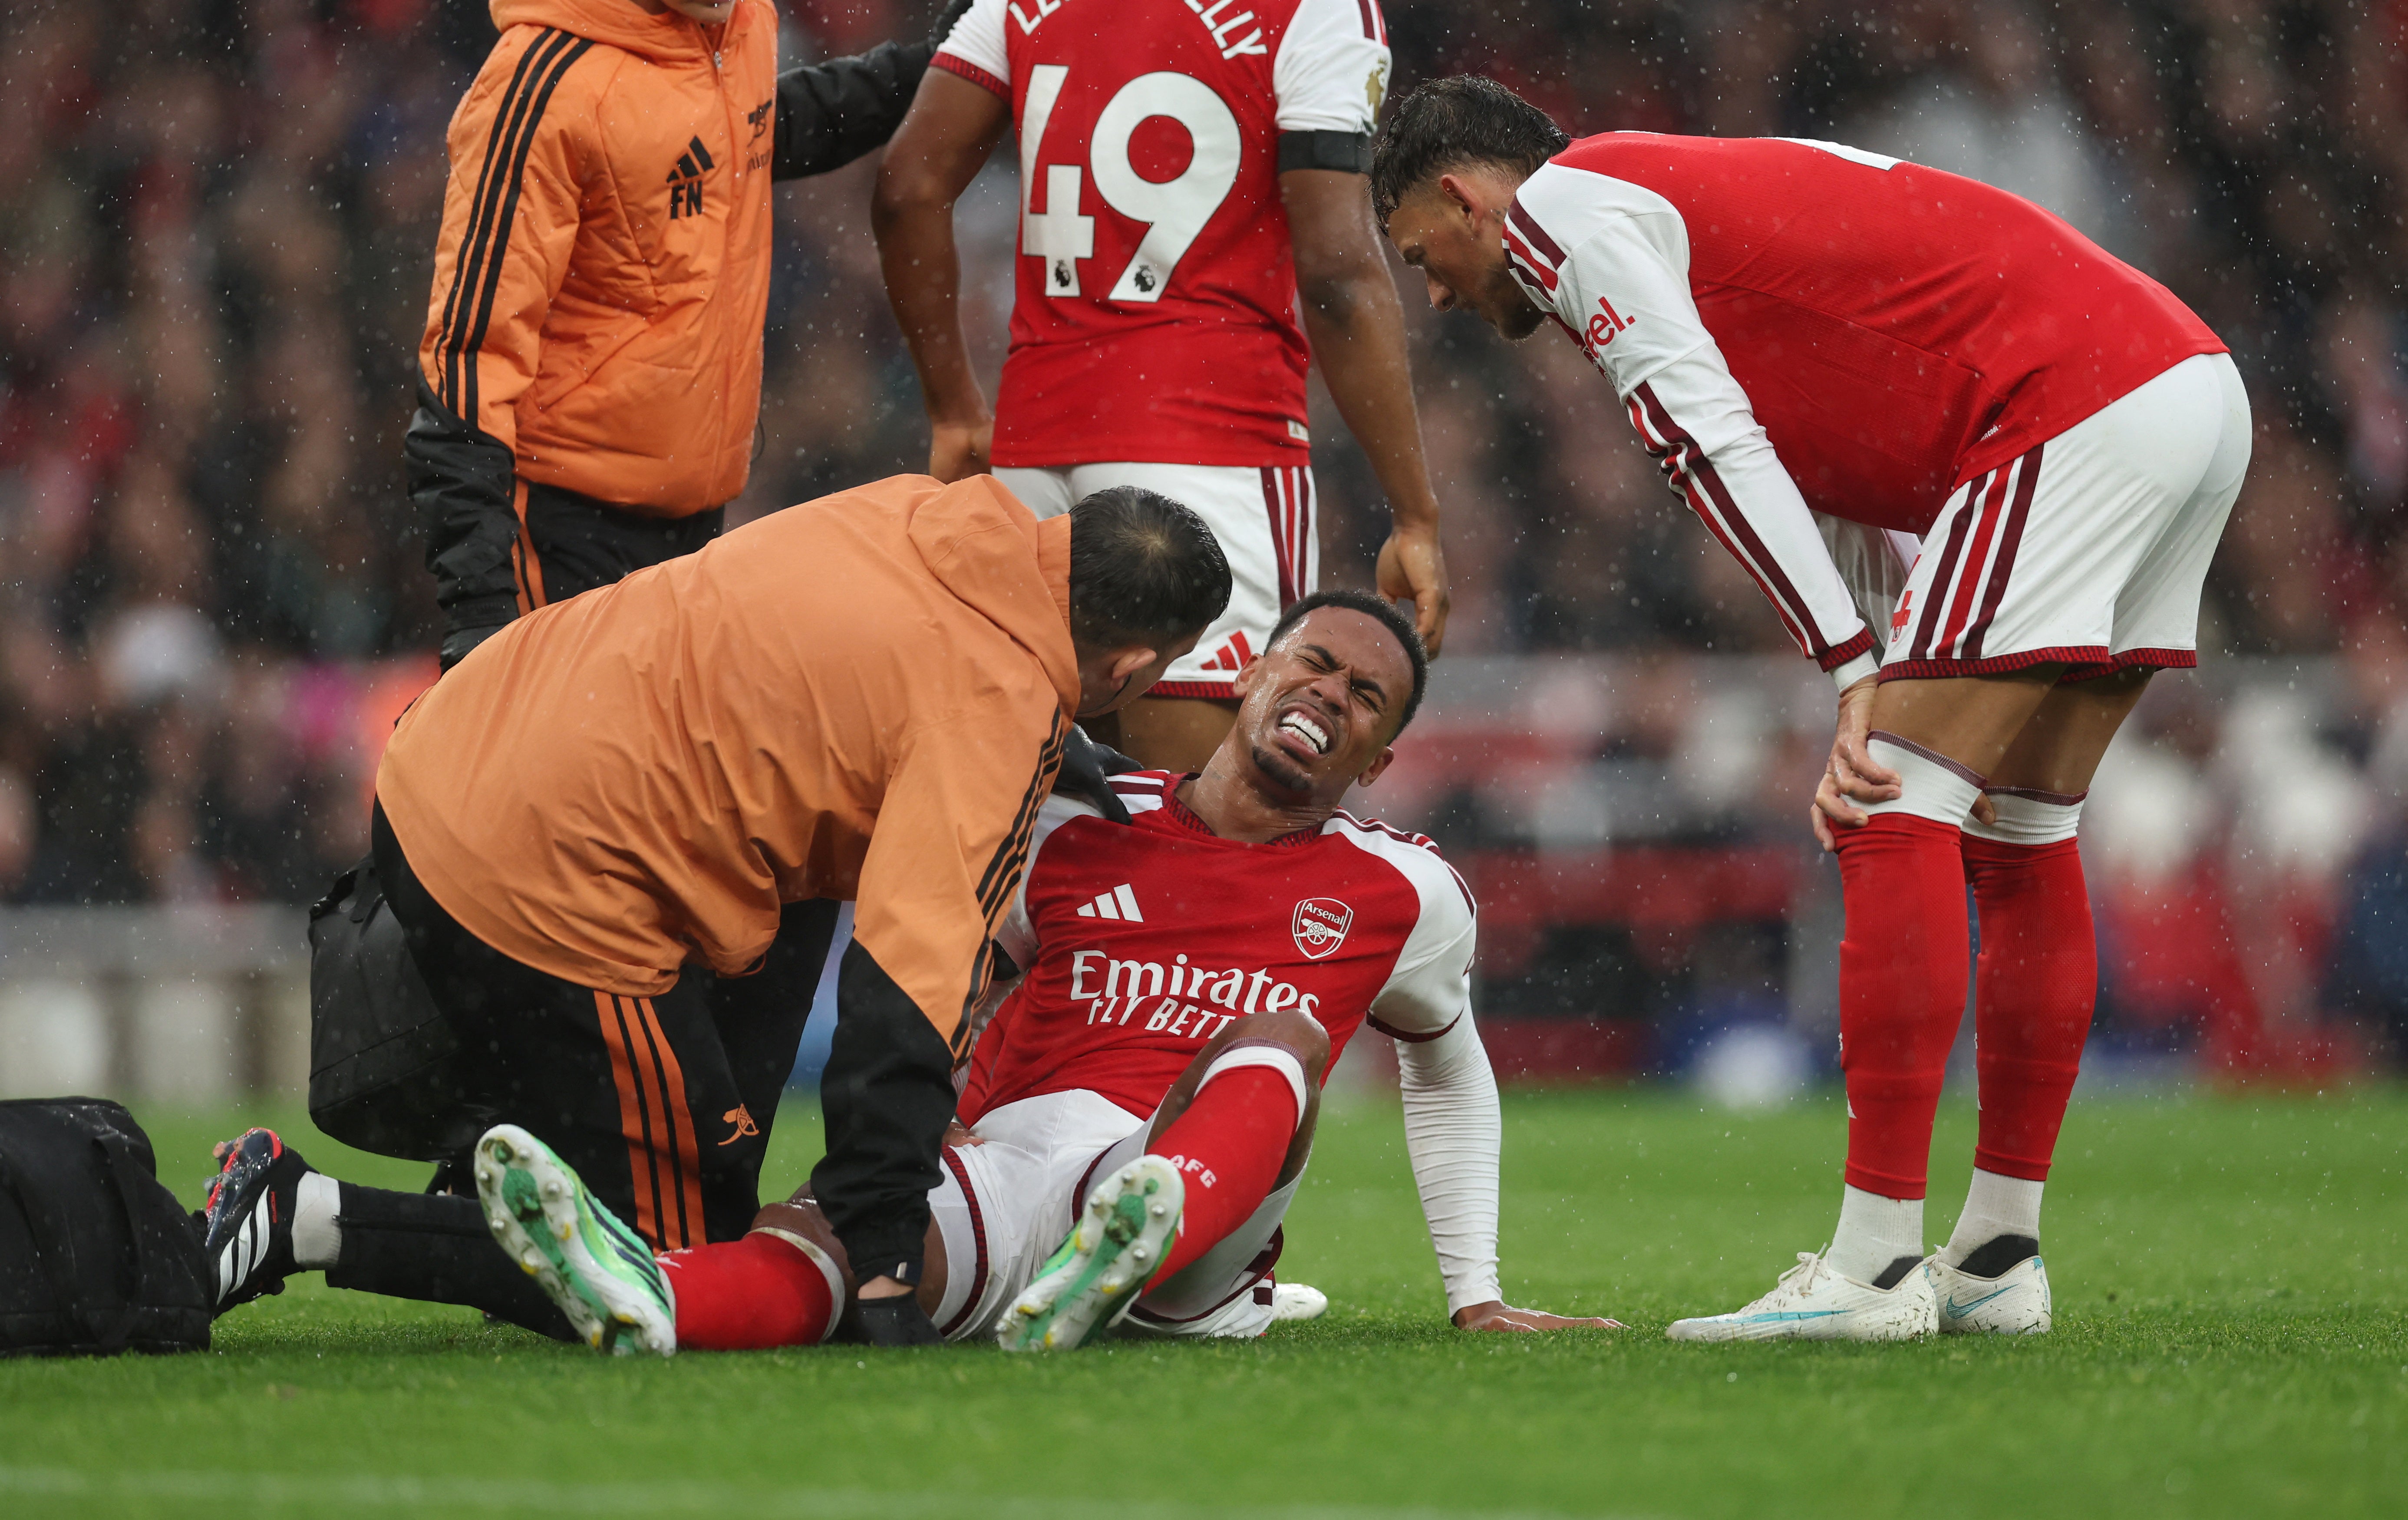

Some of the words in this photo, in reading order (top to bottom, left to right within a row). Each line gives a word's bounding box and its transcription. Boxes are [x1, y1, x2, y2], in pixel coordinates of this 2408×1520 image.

[670, 180, 703, 219] FN
[1020, 64, 1242, 303] 49
[1304, 902, 1345, 925] Arsenal
[1070, 950, 1320, 1018] Emirates
[1144, 997, 1237, 1039] BETT
